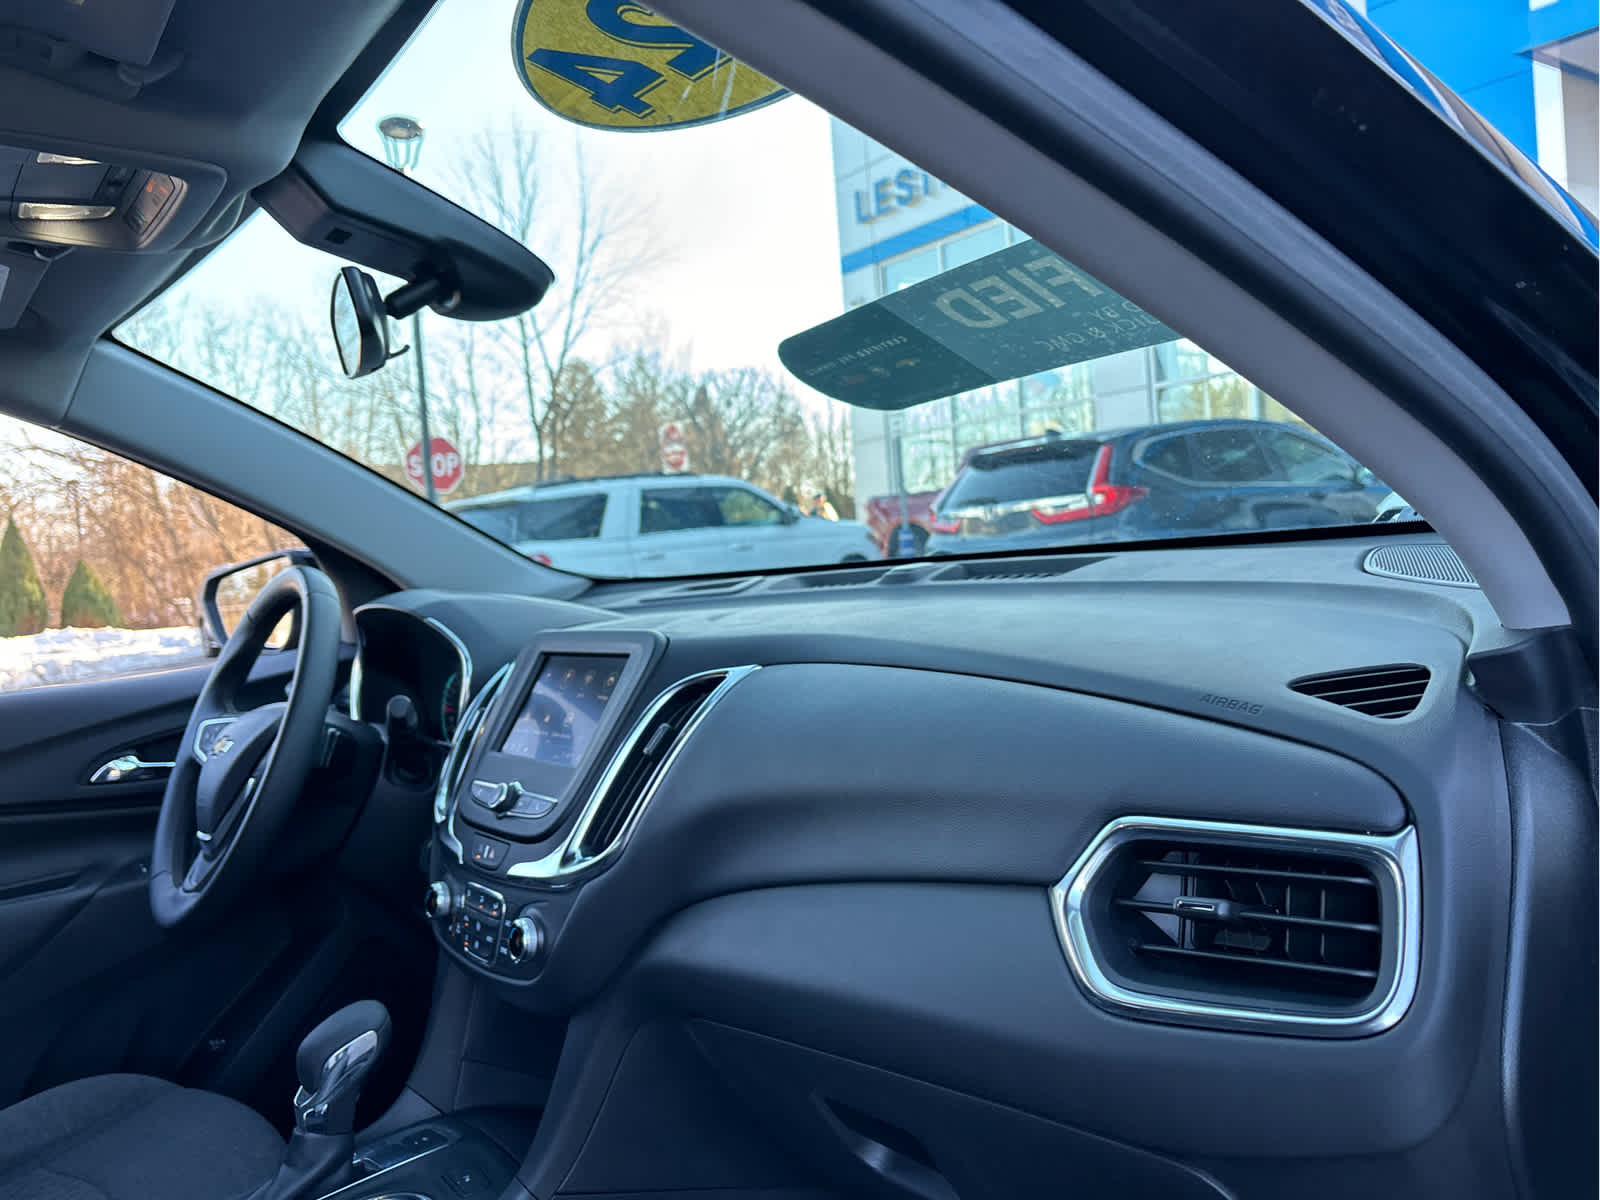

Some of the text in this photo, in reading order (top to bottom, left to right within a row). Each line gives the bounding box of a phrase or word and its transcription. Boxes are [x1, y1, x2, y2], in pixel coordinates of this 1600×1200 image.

[853, 168, 947, 224] LEST
[409, 451, 459, 478] SOP
[1200, 693, 1264, 715] AIRBAG
